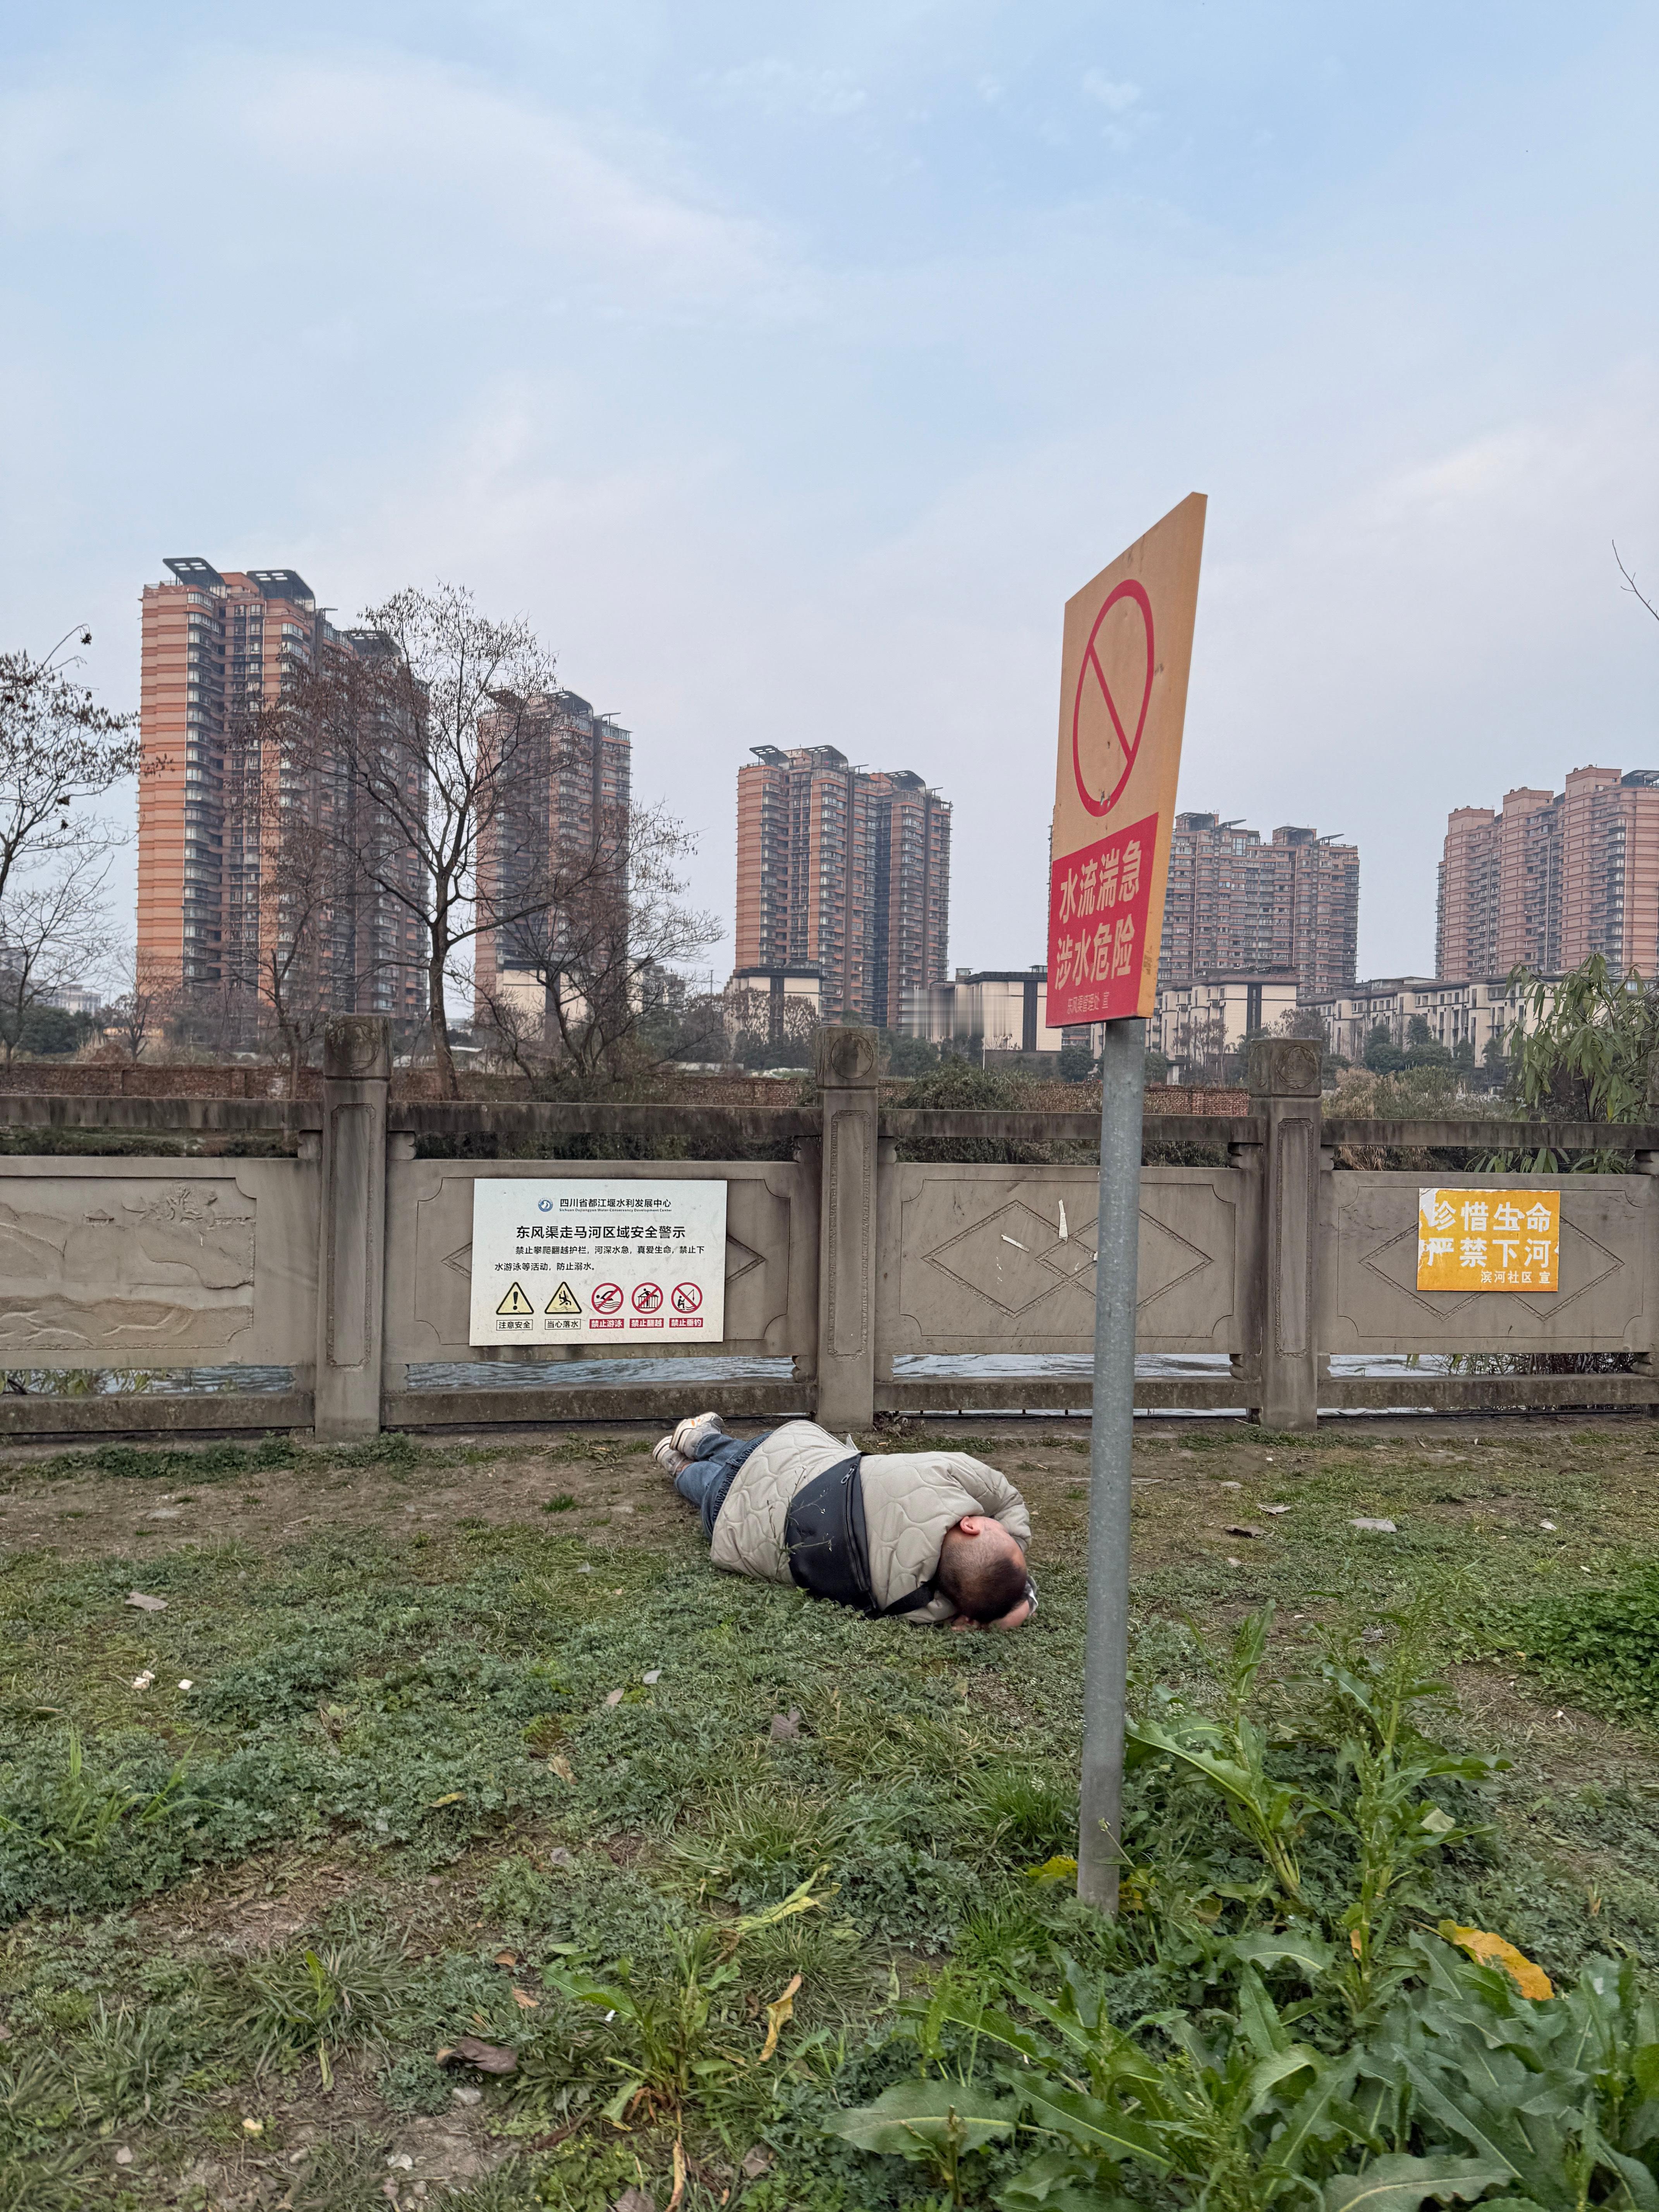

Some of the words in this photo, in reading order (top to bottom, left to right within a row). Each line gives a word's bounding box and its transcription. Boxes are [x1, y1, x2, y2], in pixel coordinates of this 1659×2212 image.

[1059, 840, 1142, 924] 水流湍急
[1054, 914, 1135, 990] 涉水危险
[560, 1198, 671, 1207] 四川省都江堰水利发展中心
[516, 1225, 685, 1239] 东风渠走马河区域安全警示
[1426, 1237, 1551, 1268] 严禁下河
[495, 1262, 595, 1271] 水游泳等活动，防止溺水。
[1480, 1270, 1532, 1283] 滨河社区
[1539, 1271, 1551, 1284] 宣
[498, 1321, 530, 1329] 注意安全
[547, 1321, 578, 1329] 当心落水
[591, 1319, 622, 1328] 禁止游泳
[631, 1319, 663, 1328] 禁止翻越
[671, 1319, 702, 1328] 禁止垂钓
